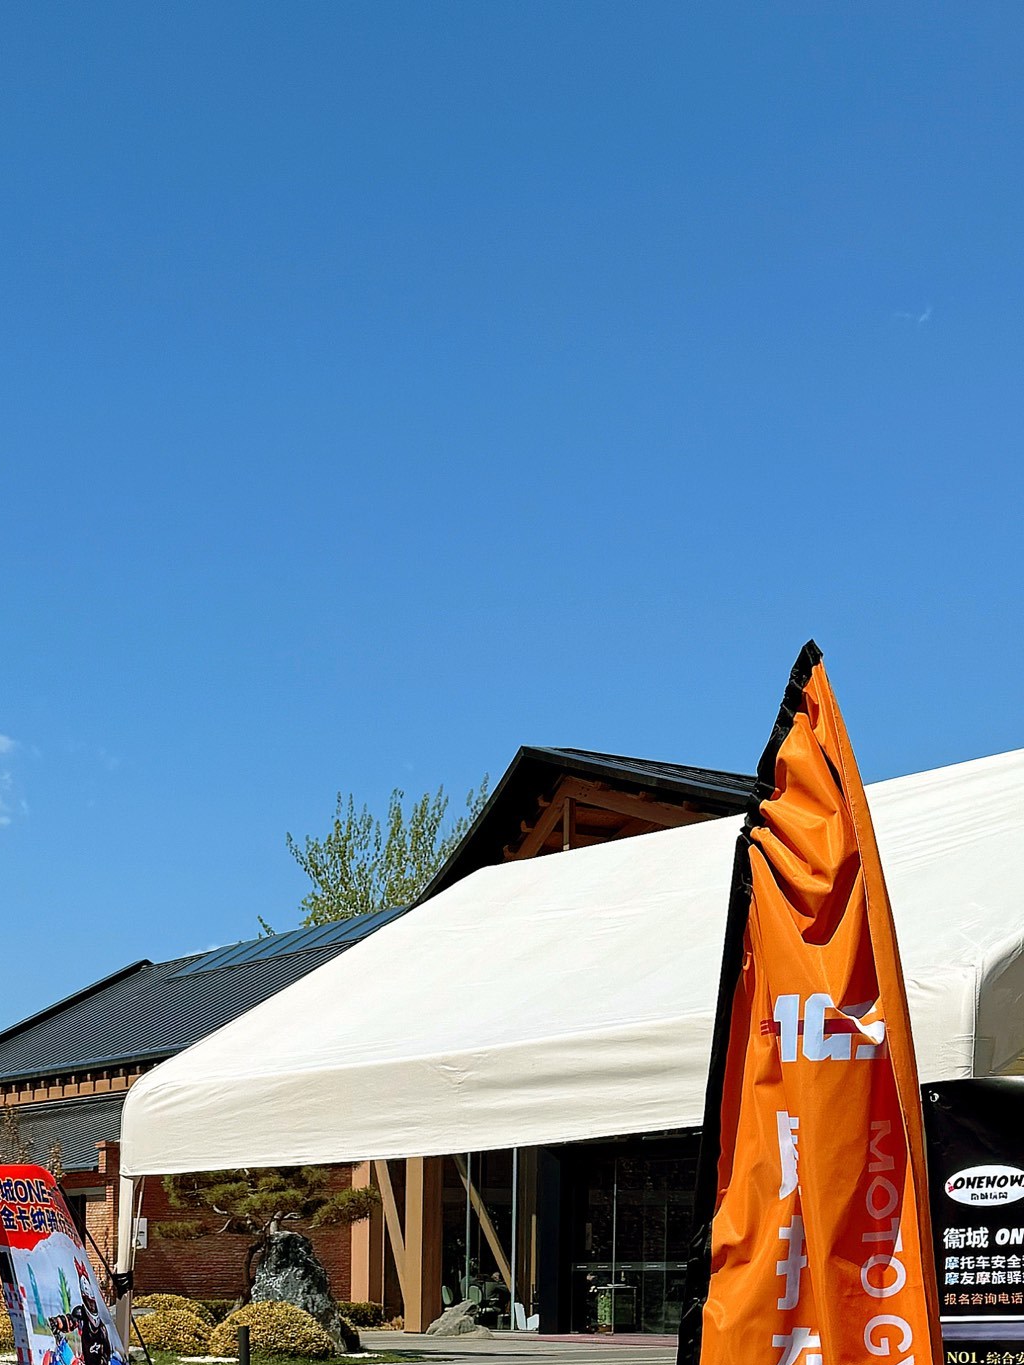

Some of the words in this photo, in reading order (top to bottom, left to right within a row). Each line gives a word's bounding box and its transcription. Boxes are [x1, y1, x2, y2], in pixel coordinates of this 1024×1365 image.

[952, 1174, 1023, 1191] ONENOW
[944, 1254, 1024, 1270] 摩托车安全
[944, 1271, 1024, 1286] 摩友摩旅驿
